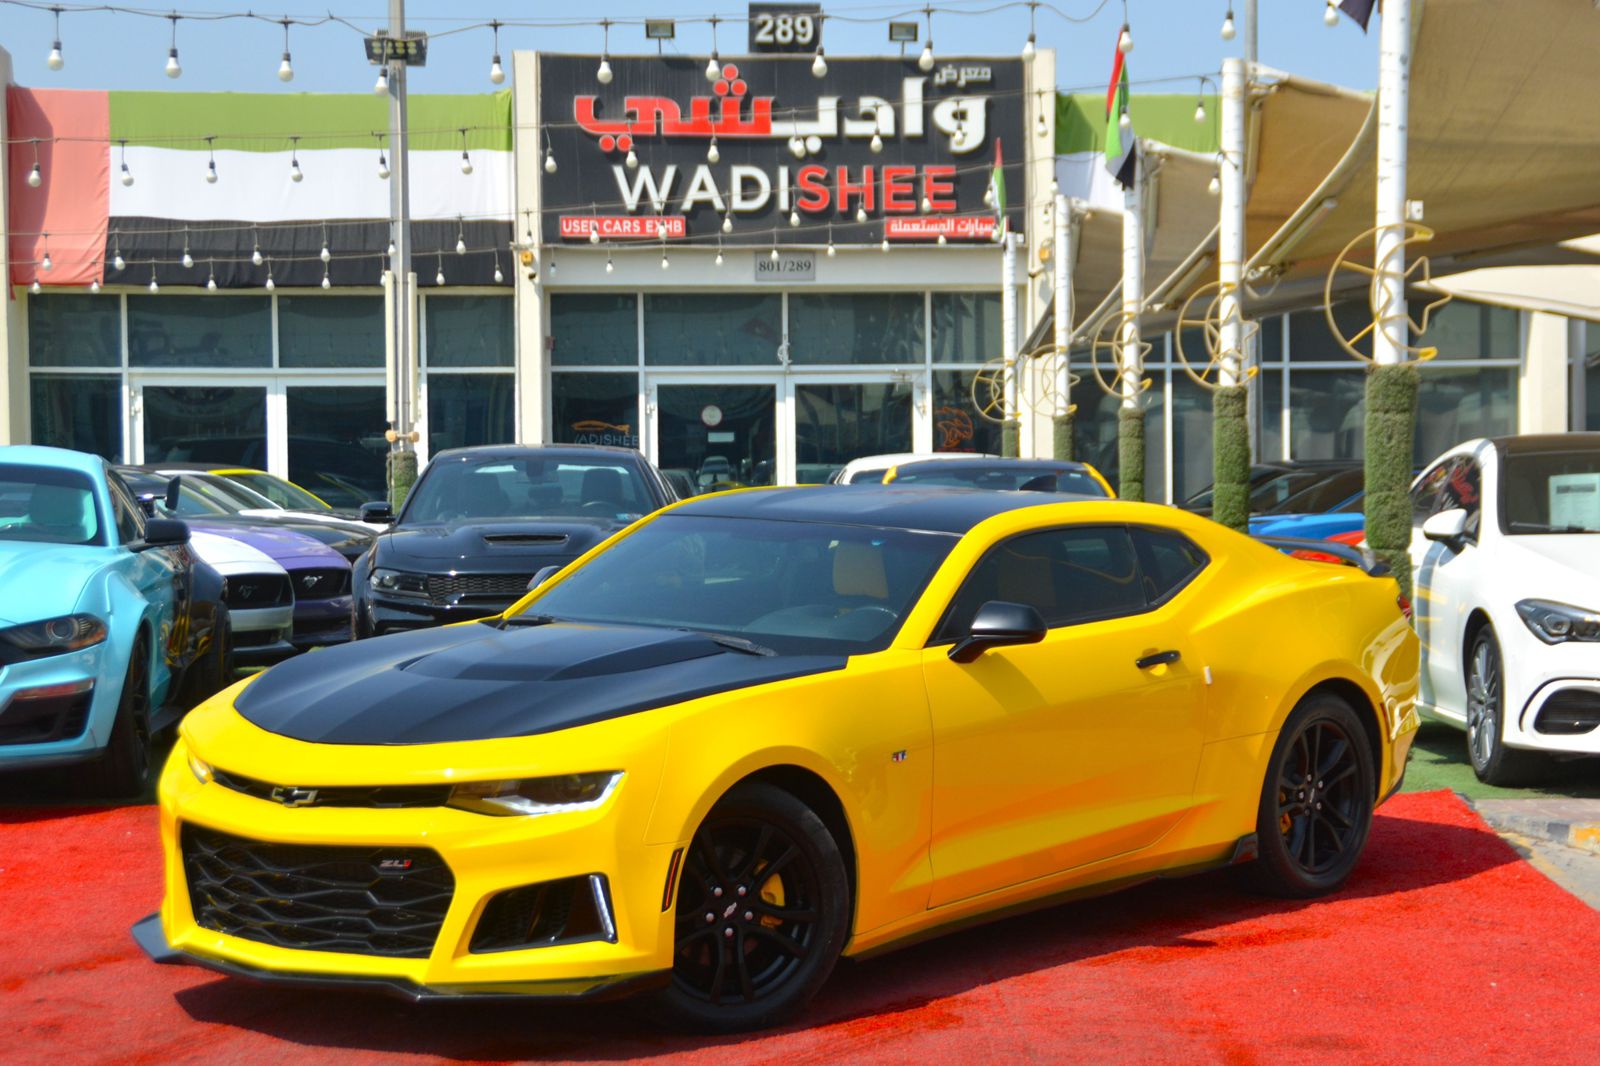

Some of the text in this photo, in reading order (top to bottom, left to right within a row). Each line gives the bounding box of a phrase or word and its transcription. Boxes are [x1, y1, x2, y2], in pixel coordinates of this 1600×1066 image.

[755, 13, 814, 44] 289
[934, 64, 992, 86] معرض
[612, 165, 956, 212] WADISHEE
[562, 219, 599, 233] USED
[603, 219, 641, 233] CARS
[758, 260, 812, 272] 801/289
